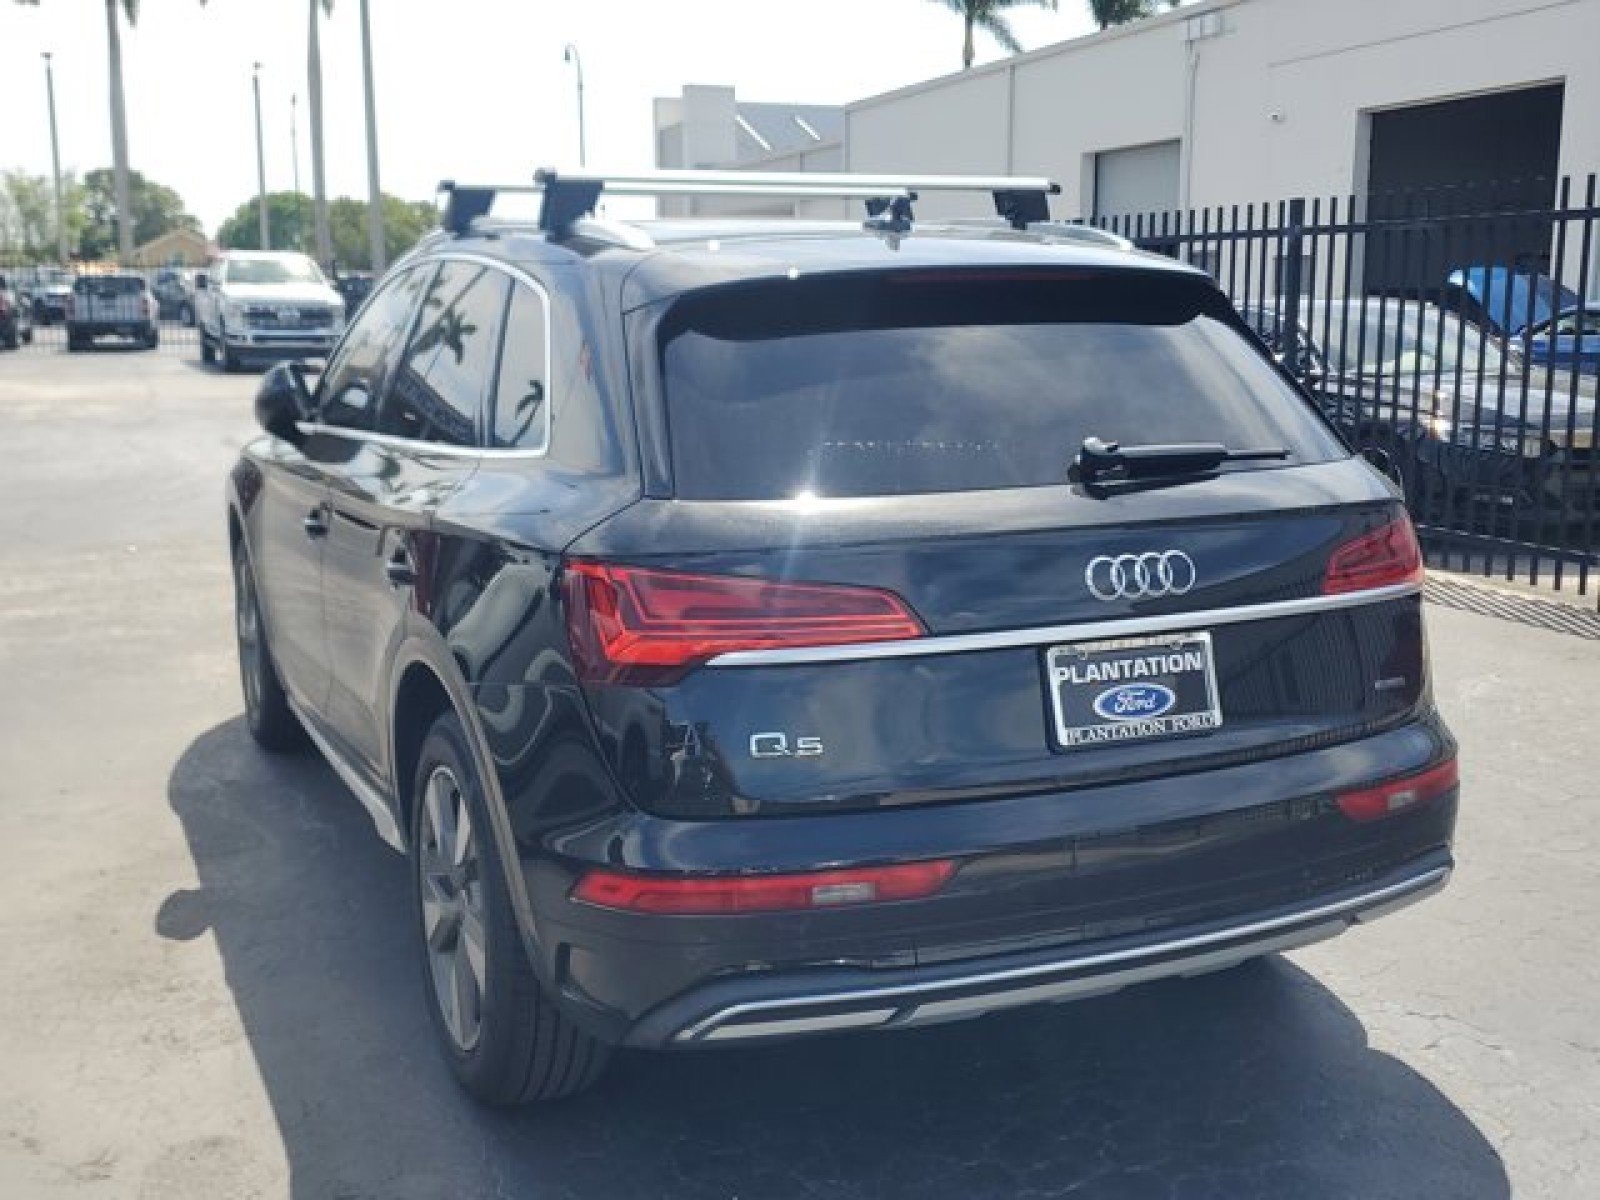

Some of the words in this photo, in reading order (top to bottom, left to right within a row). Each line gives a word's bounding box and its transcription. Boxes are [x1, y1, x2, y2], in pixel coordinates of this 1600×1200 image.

[1053, 651, 1202, 684] PLANTATION
[1113, 688, 1157, 714] Ford
[749, 731, 824, 758] Q5
